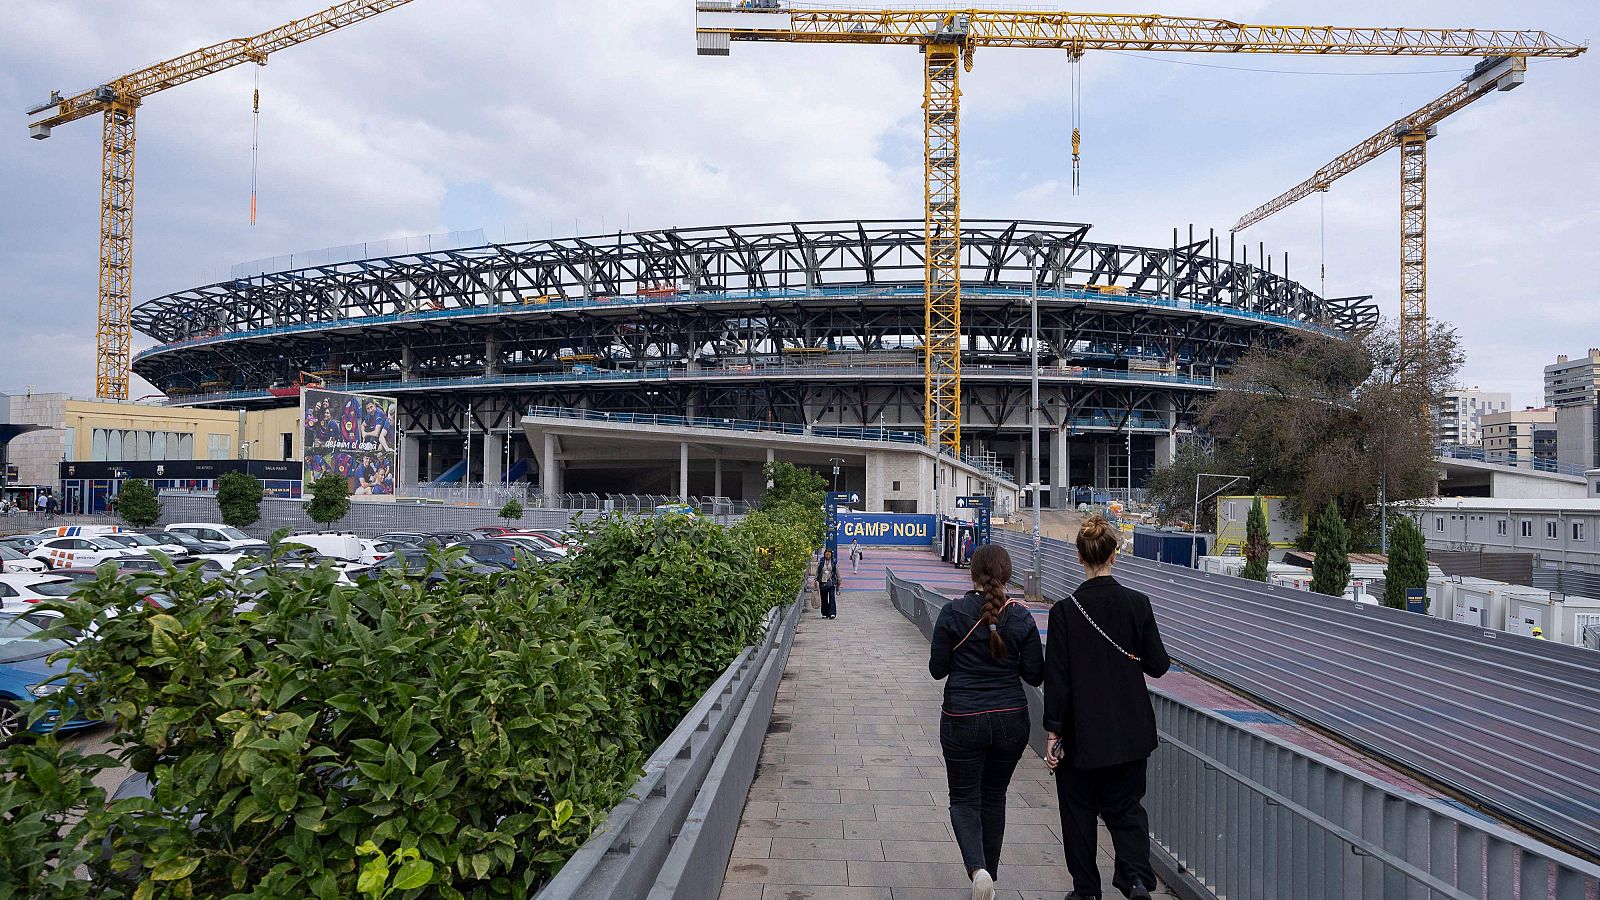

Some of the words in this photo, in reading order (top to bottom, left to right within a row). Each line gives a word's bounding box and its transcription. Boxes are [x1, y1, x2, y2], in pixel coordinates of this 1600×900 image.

[351, 440, 359, 449] el
[844, 522, 890, 537] CAMP
[893, 523, 927, 537] NOU
